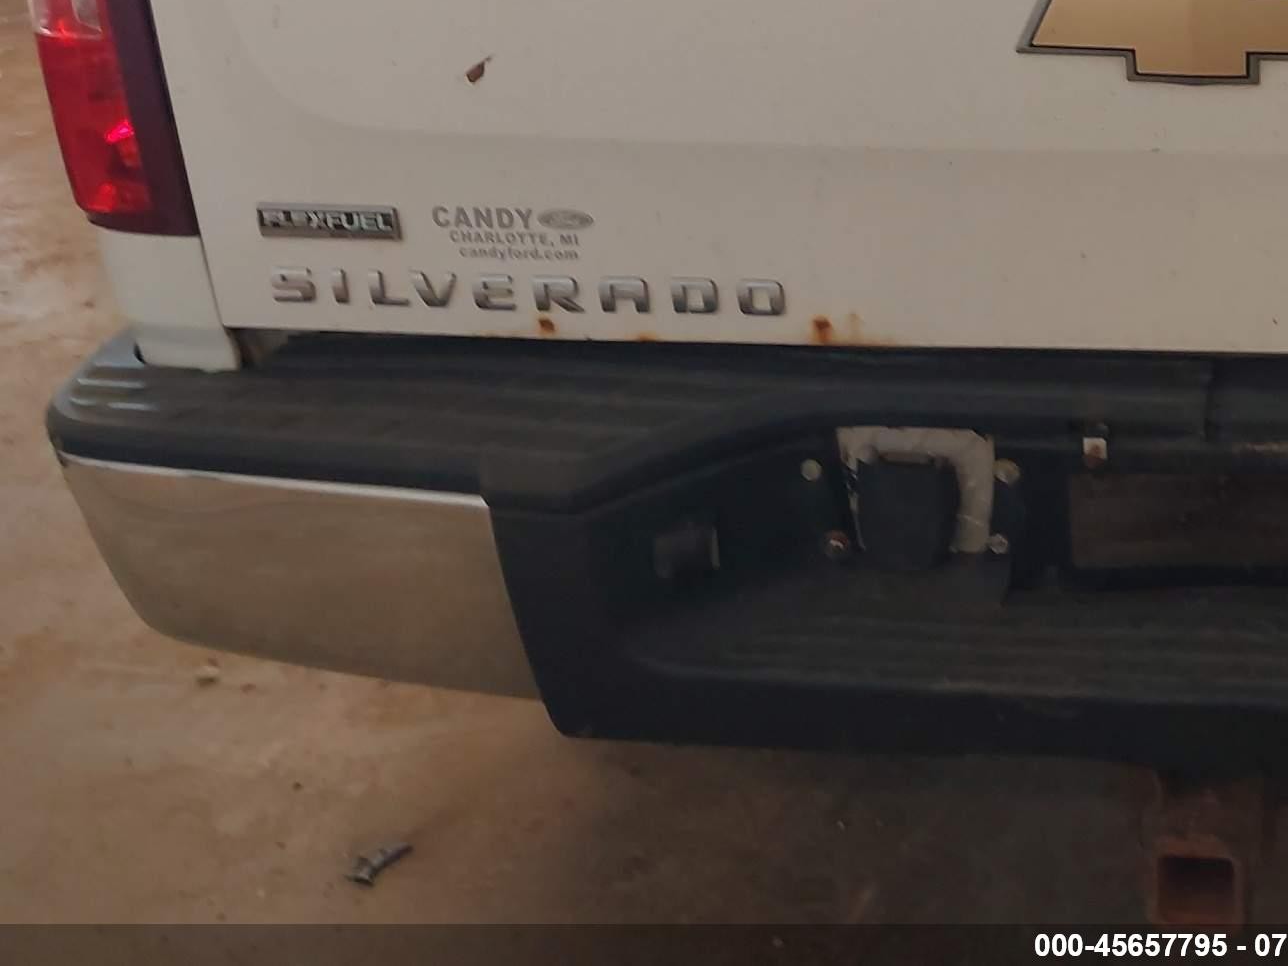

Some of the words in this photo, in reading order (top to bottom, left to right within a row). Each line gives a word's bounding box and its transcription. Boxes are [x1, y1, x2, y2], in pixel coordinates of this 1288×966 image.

[262, 208, 393, 232] FLEXFUEL
[432, 205, 533, 230] CANDY
[450, 230, 555, 247] CHARLOTTE,
[560, 234, 580, 247] MI
[459, 246, 579, 260] candyford.com
[271, 266, 787, 316] SILVERADO
